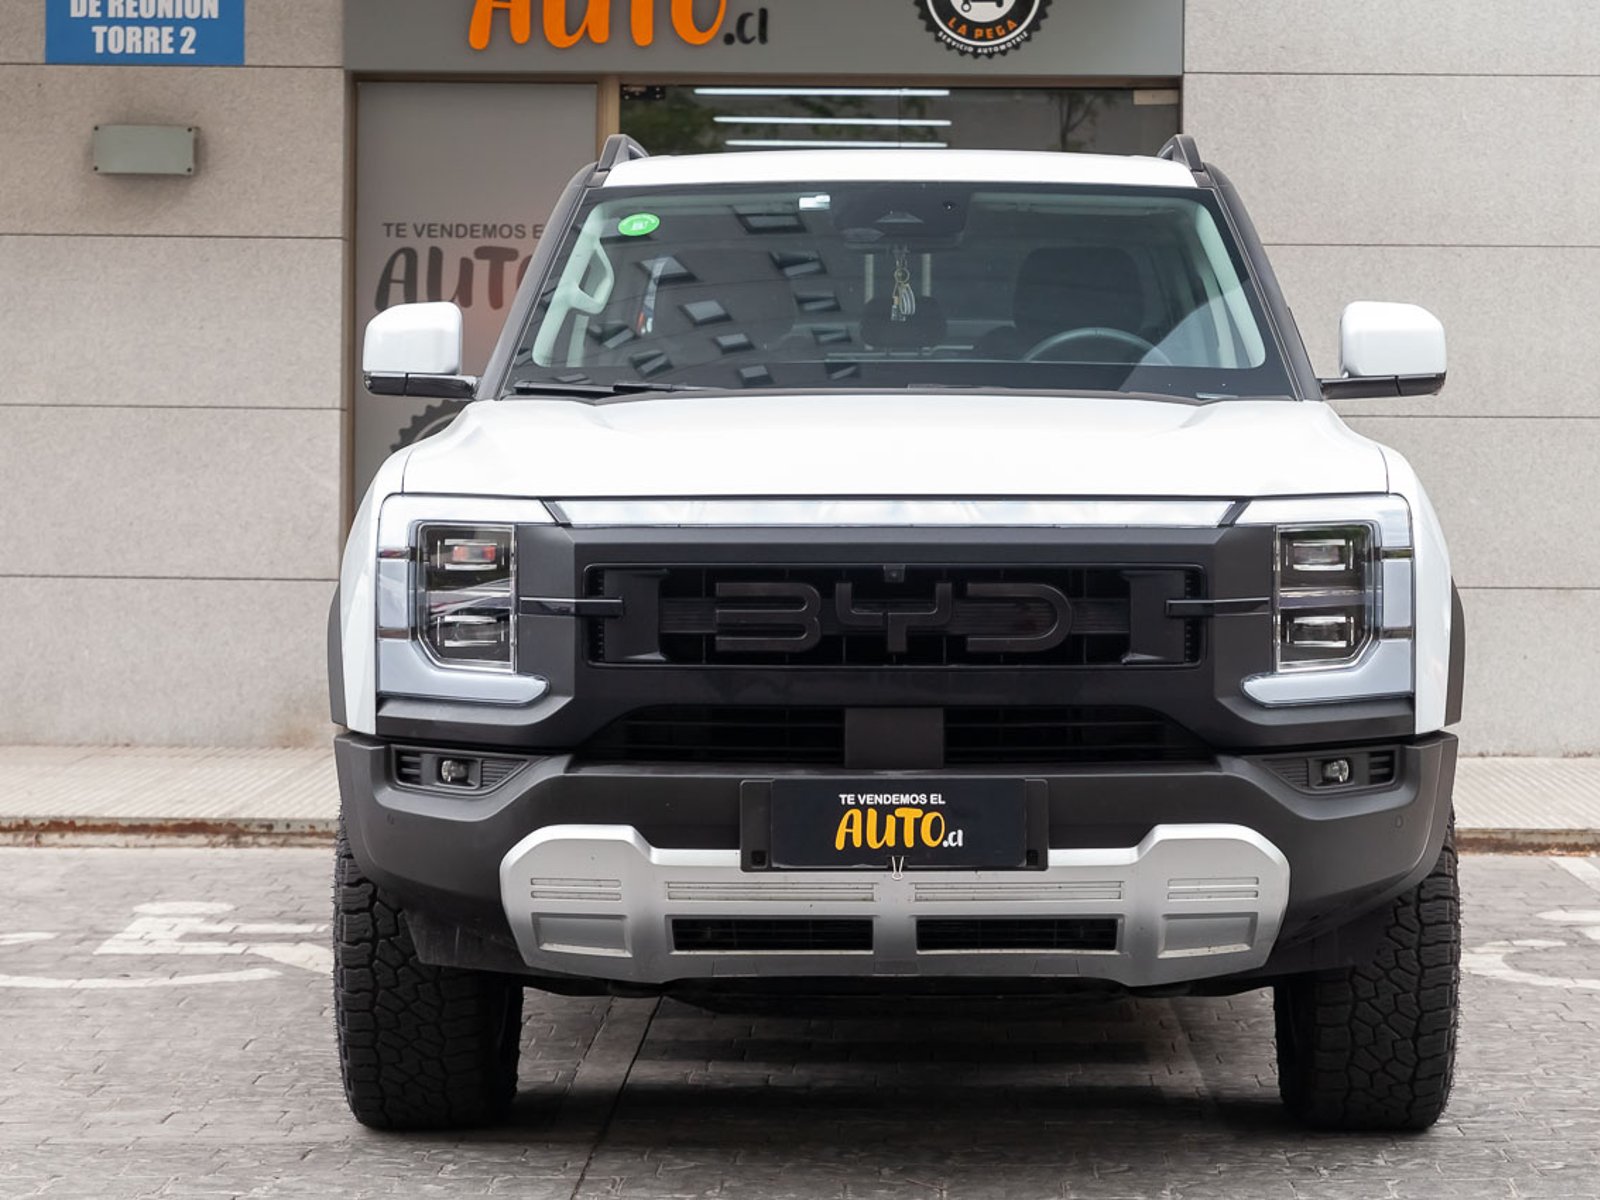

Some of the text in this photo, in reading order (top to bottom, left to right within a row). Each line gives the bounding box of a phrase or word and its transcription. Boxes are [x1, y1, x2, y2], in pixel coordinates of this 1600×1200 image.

[70, 0, 101, 18] DE
[947, 16, 1018, 39] LA PEGA
[91, 26, 196, 54] TORRE 2
[382, 223, 545, 239] TE VENDEMOS E
[374, 246, 534, 311] AUT
[715, 581, 1073, 652] BYD
[839, 793, 946, 805] TE VENDEMOS EL
